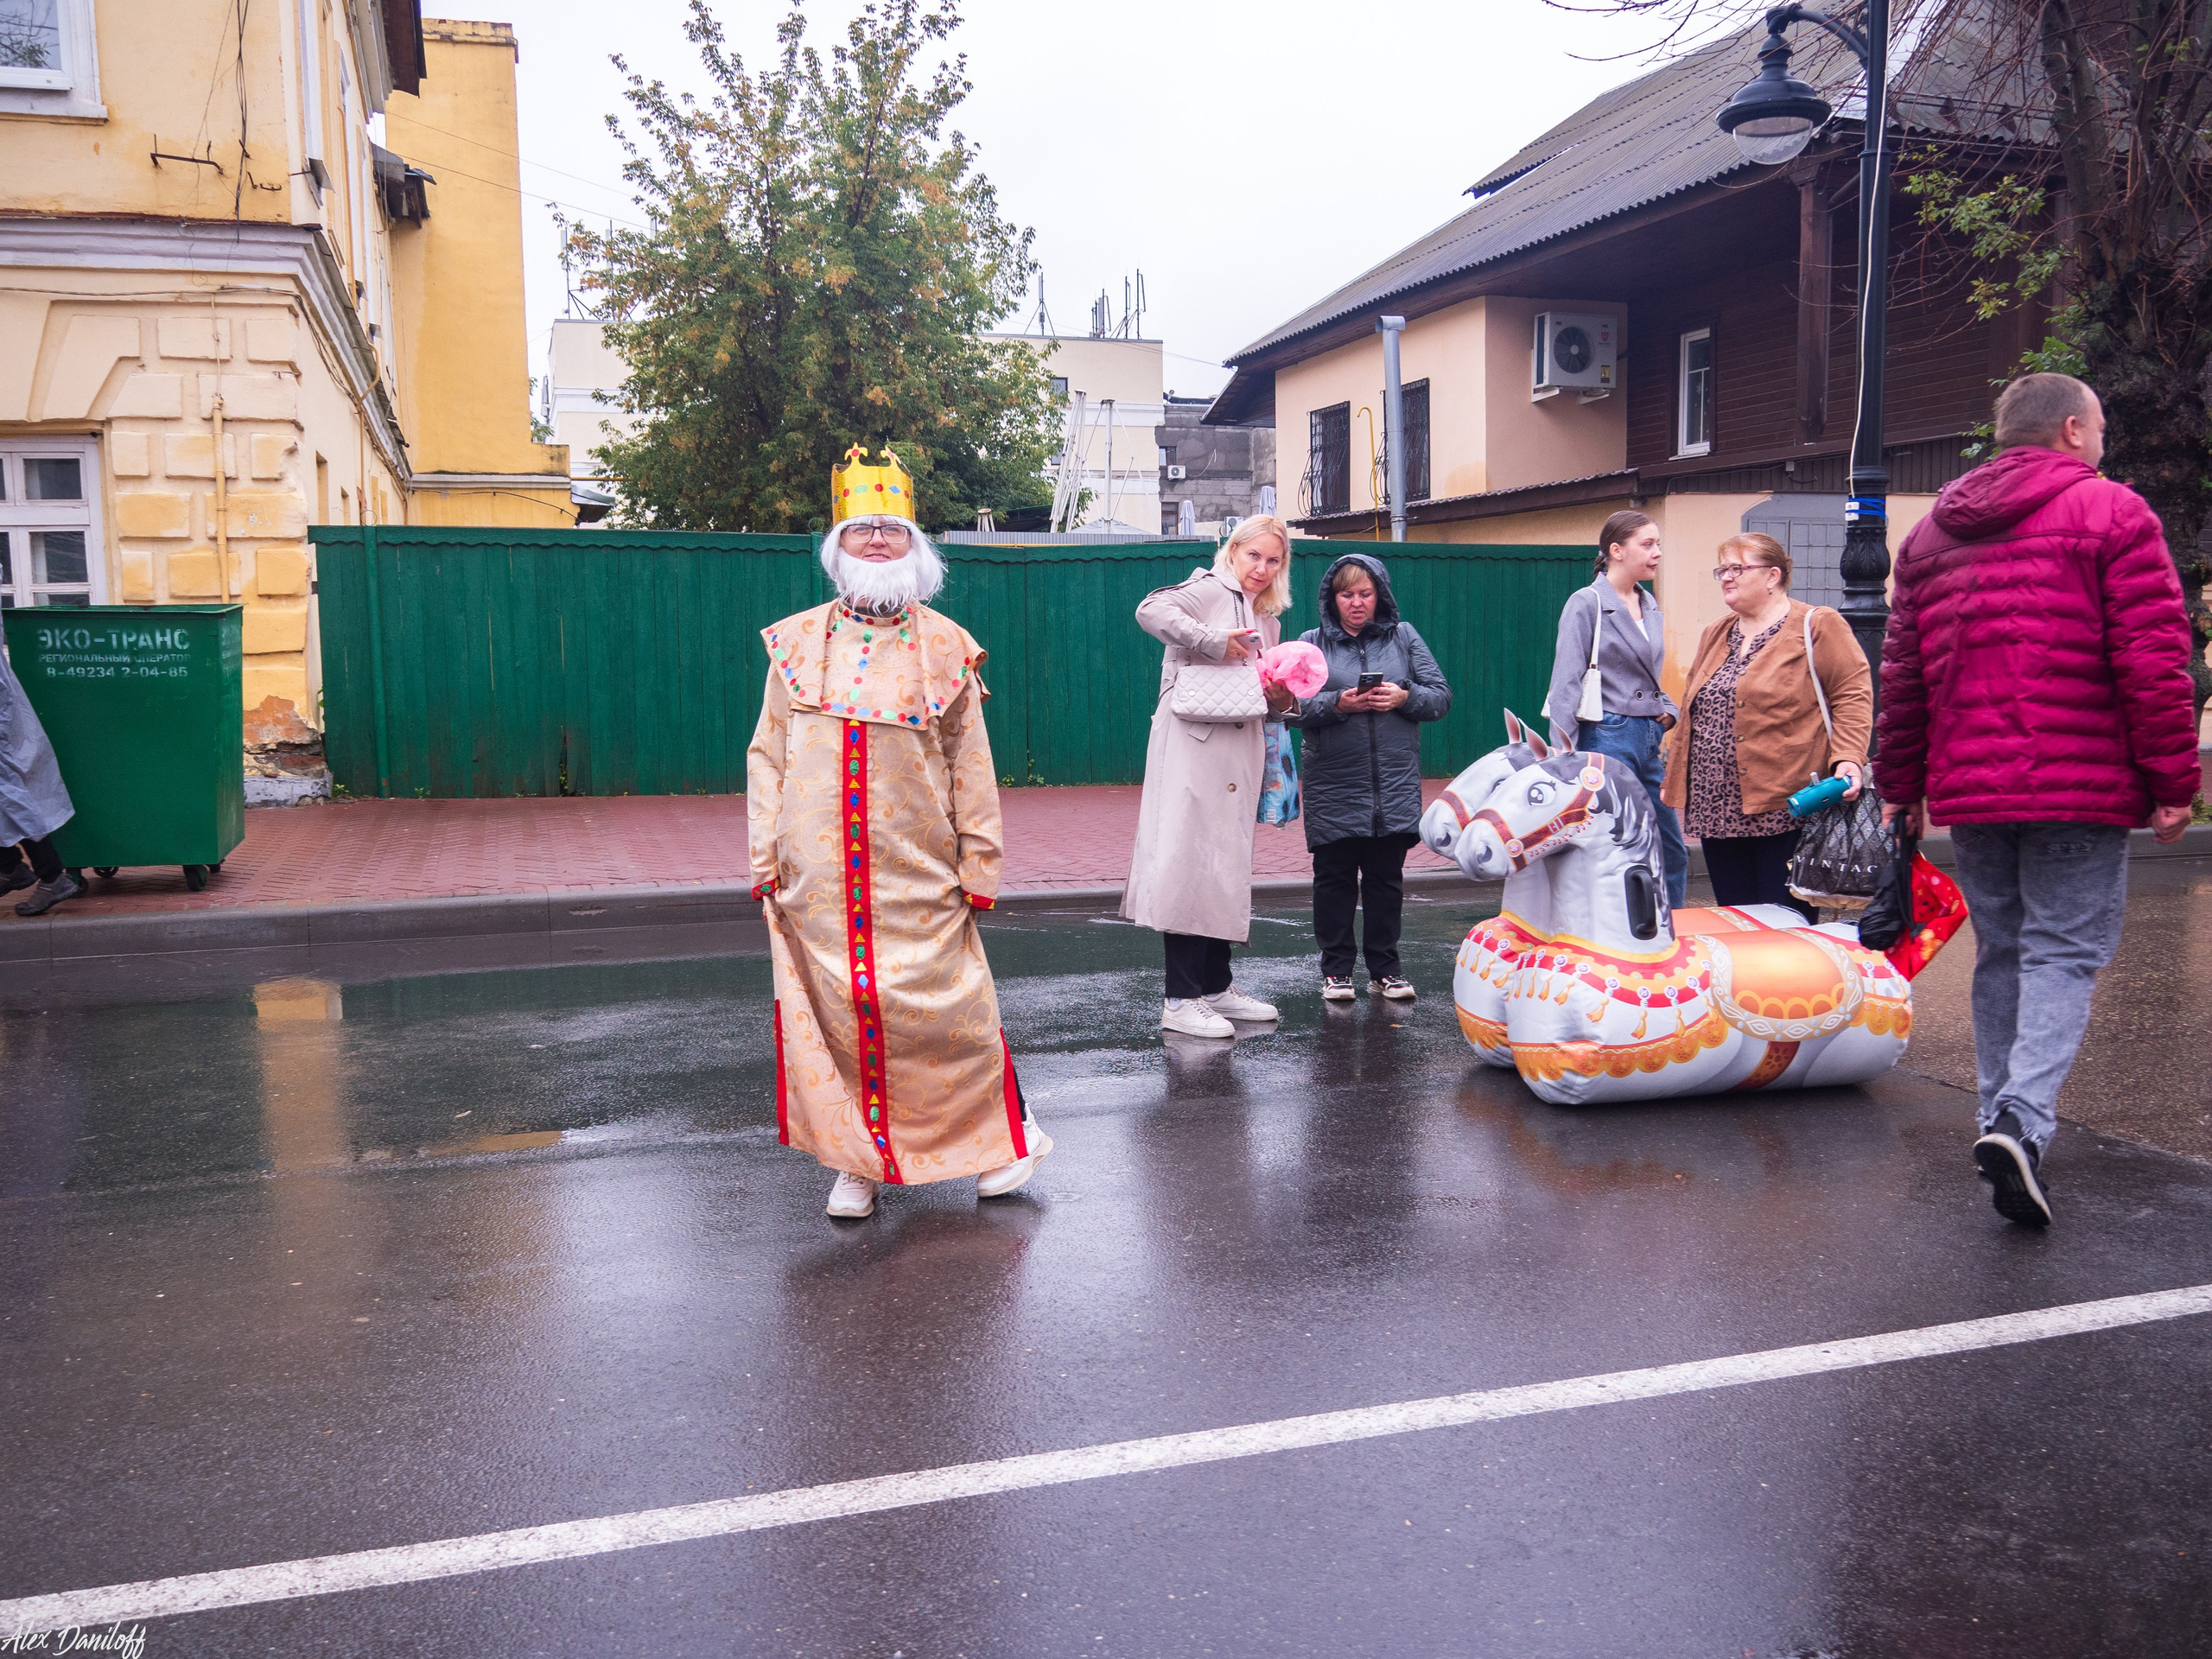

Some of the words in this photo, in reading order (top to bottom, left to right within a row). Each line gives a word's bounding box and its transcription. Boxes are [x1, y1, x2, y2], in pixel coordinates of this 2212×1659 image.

[37, 627, 190, 650] ЭКО-ТРАНС
[47, 666, 115, 677] 8-49234
[121, 666, 188, 677] 2-04-85
